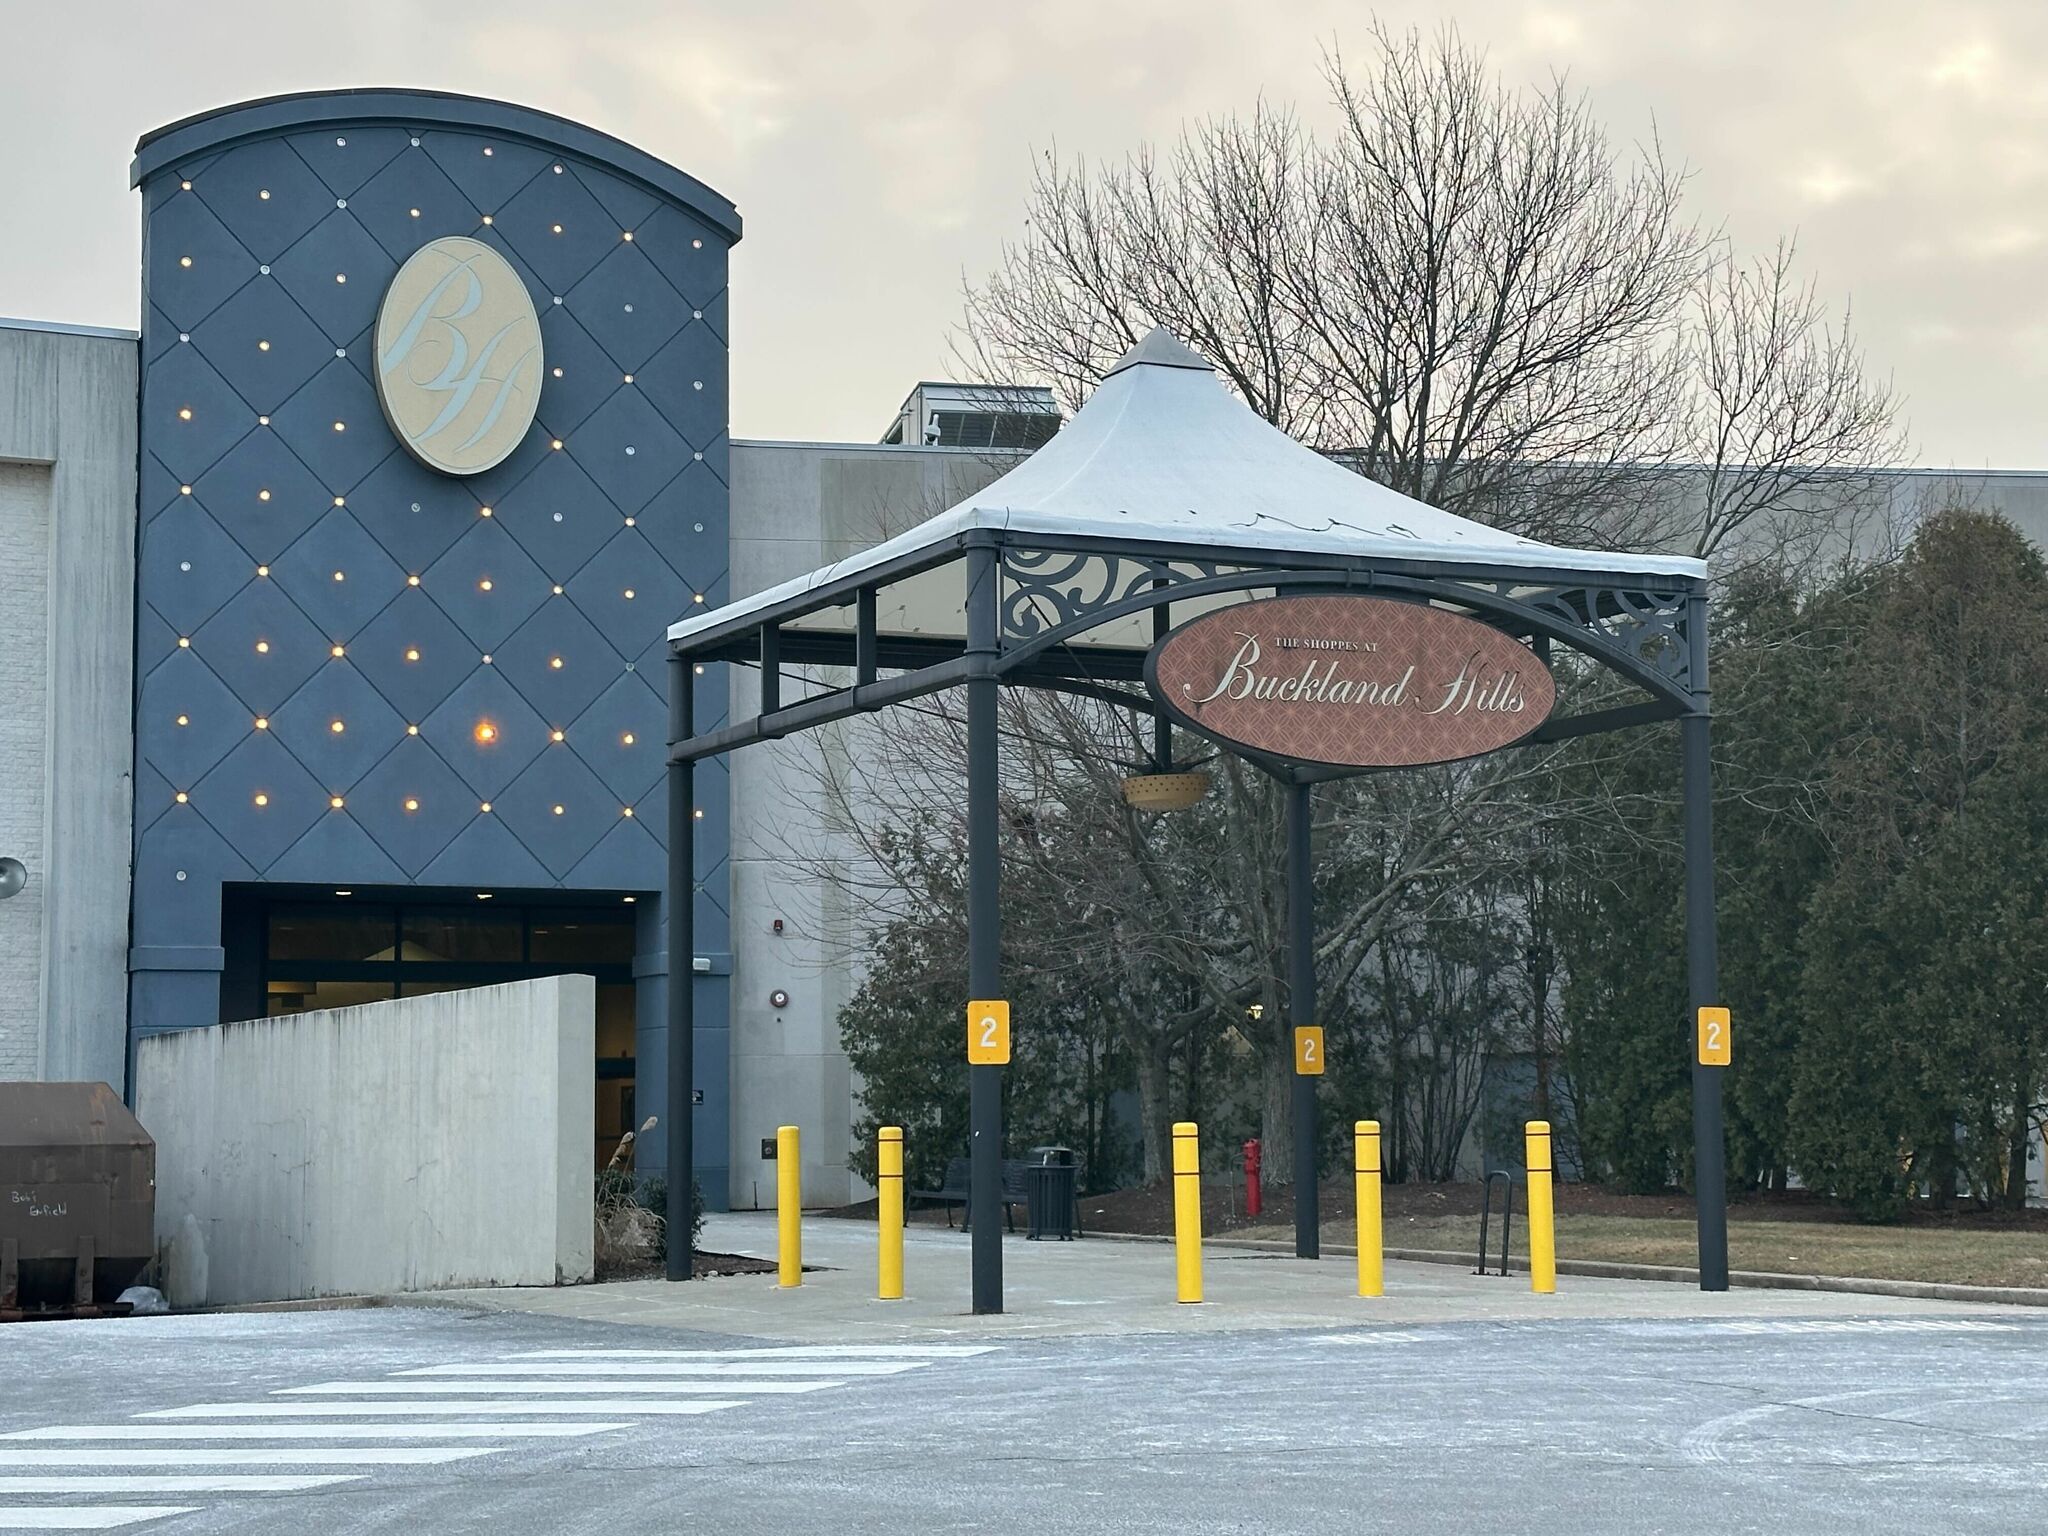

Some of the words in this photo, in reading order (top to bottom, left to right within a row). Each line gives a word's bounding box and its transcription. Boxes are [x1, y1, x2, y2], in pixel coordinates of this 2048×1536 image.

[1275, 637, 1300, 649] THE
[1303, 639, 1359, 651] SHOPPES
[1363, 642, 1378, 653] AT
[1183, 631, 1415, 706] Buckland
[1414, 650, 1525, 715] Hills
[980, 1016, 997, 1048] 2
[1704, 1022, 1721, 1050] 2
[1304, 1038, 1316, 1062] 2
